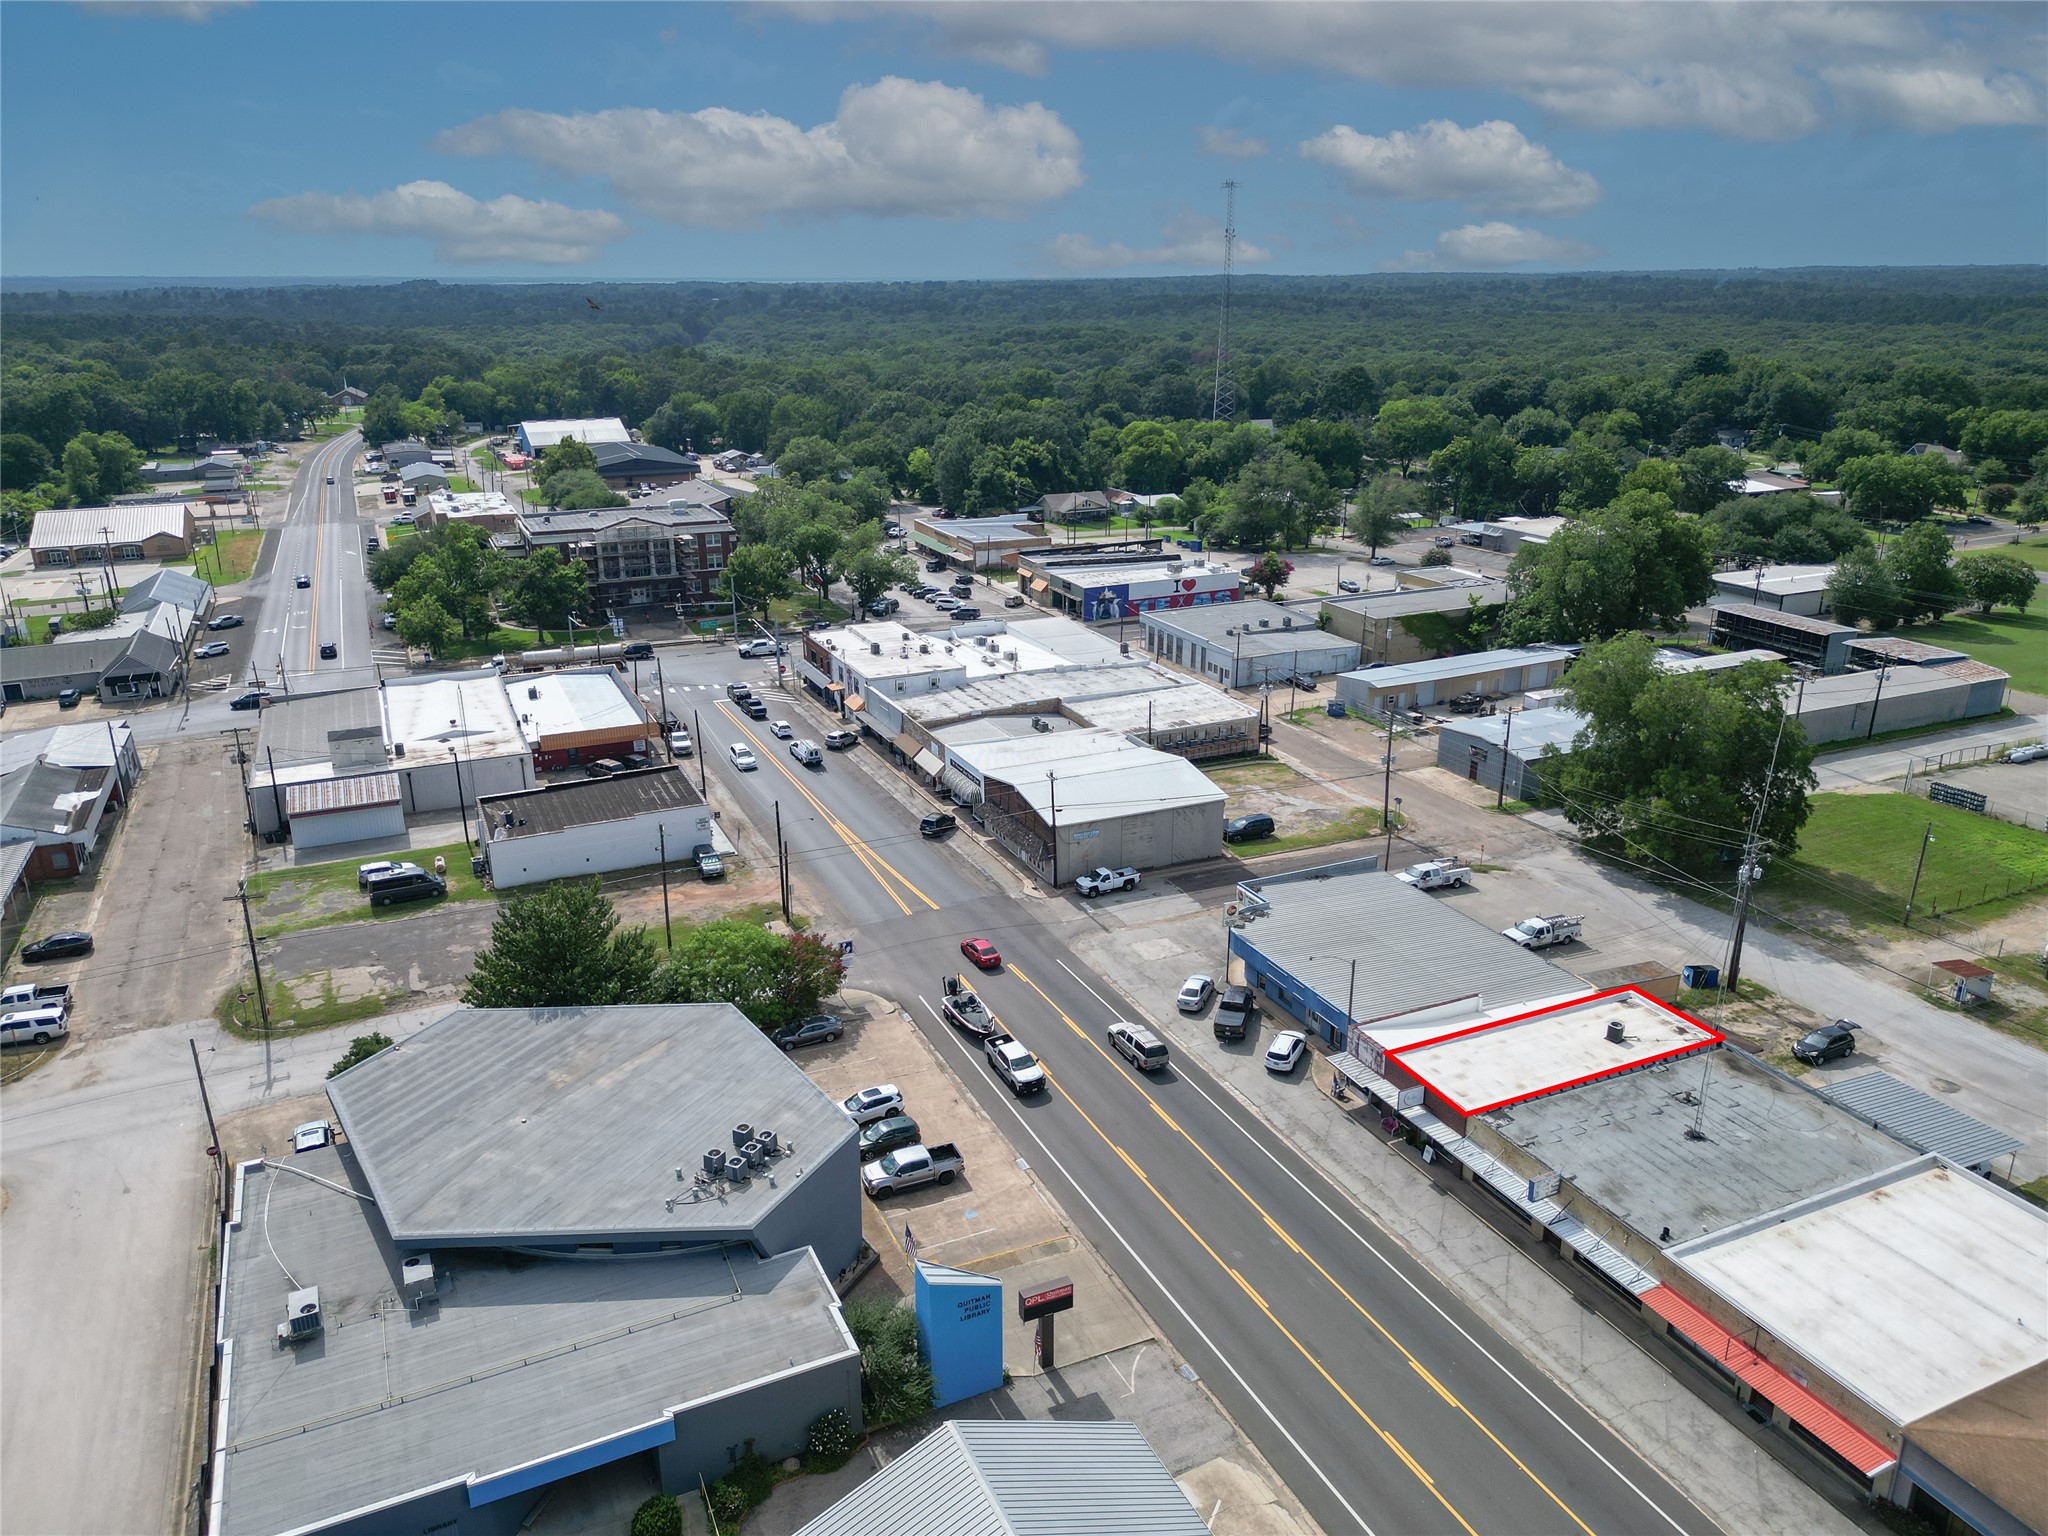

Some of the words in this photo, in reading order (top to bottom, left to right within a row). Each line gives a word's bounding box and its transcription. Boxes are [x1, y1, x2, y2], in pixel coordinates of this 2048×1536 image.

[1173, 580, 1181, 593] I
[1134, 591, 1232, 611] TEXAS
[957, 1293, 991, 1308] QUITMAN
[964, 1301, 991, 1313] PUBLIC
[1025, 1295, 1045, 1306] QPL
[960, 1308, 991, 1322] LIBRARY
[423, 1518, 458, 1534] LIBRARY
